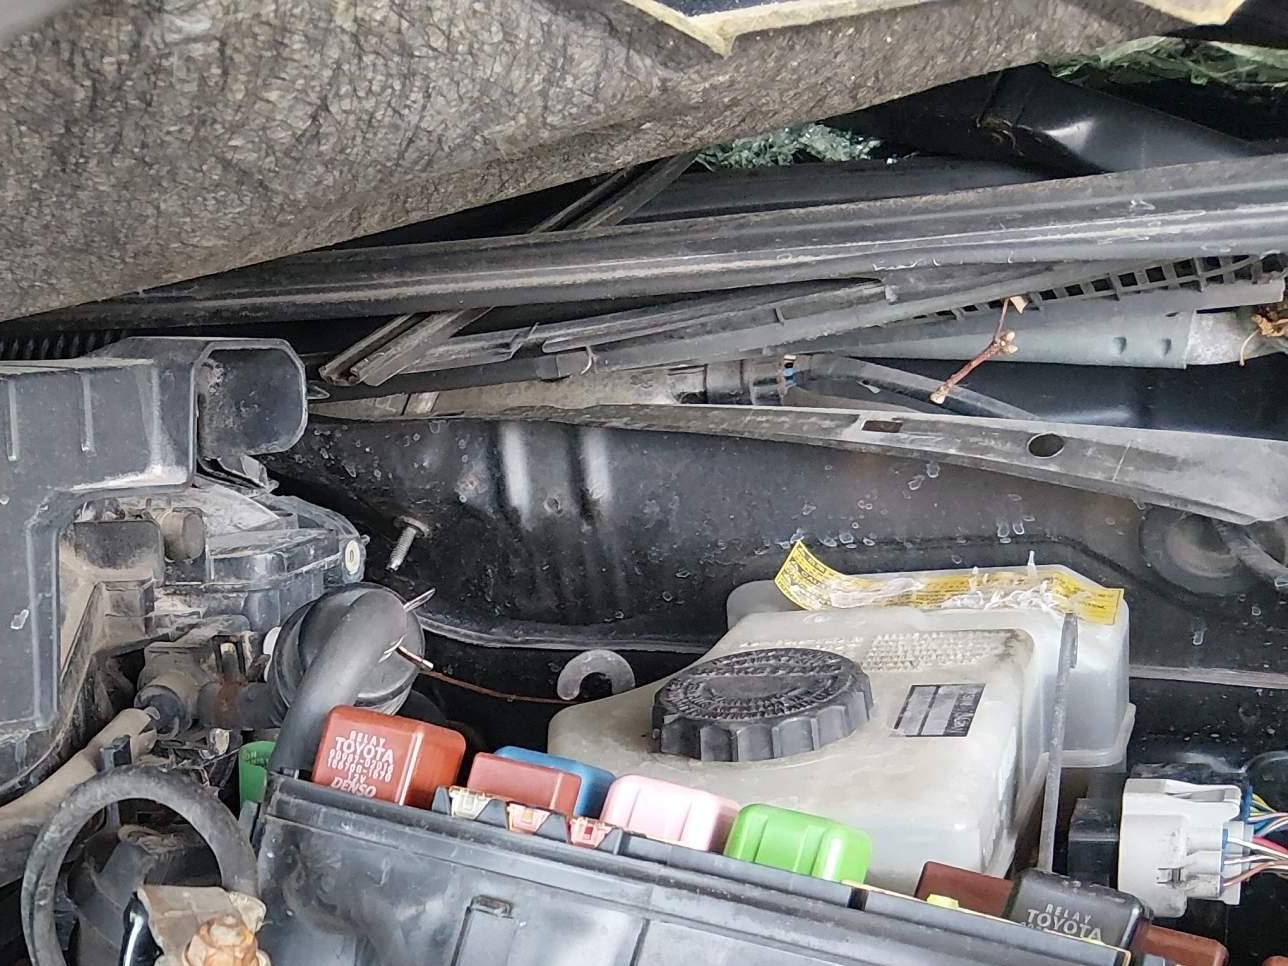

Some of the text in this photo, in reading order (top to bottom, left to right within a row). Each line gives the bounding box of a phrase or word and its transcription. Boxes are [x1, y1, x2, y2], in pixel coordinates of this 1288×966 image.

[349, 731, 386, 746] RELAY
[335, 736, 394, 764] TOYOTA
[331, 776, 377, 798] DENSO
[1045, 903, 1092, 923] RELAY
[1026, 908, 1102, 941] TOYOTA
